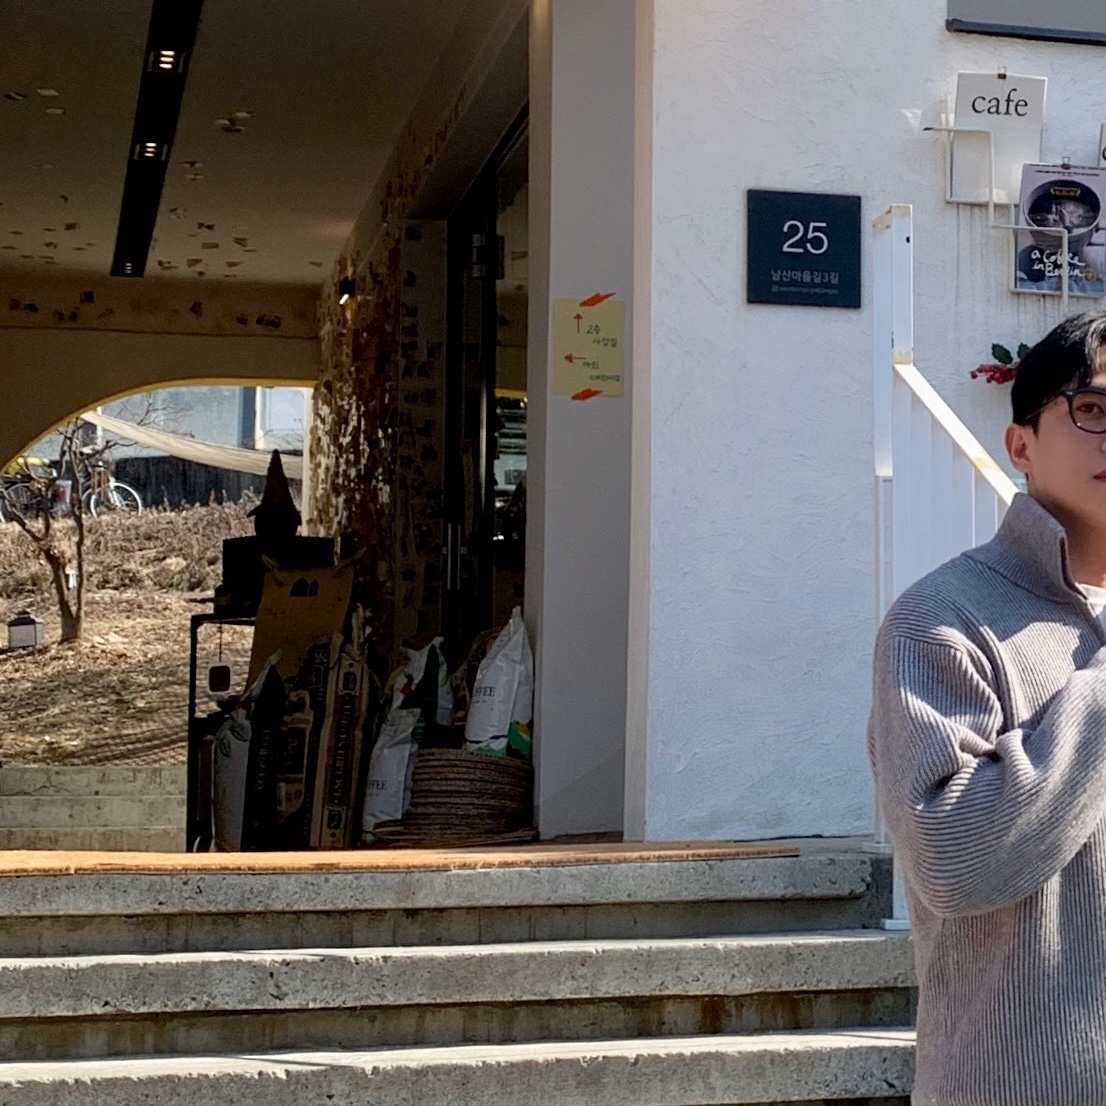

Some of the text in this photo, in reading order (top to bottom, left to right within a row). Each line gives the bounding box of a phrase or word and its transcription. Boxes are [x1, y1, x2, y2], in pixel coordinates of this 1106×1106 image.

[971, 88, 1029, 117] cafe
[782, 220, 829, 254] 25
[1043, 248, 1086, 266] Cofee
[1045, 262, 1086, 277] Belin
